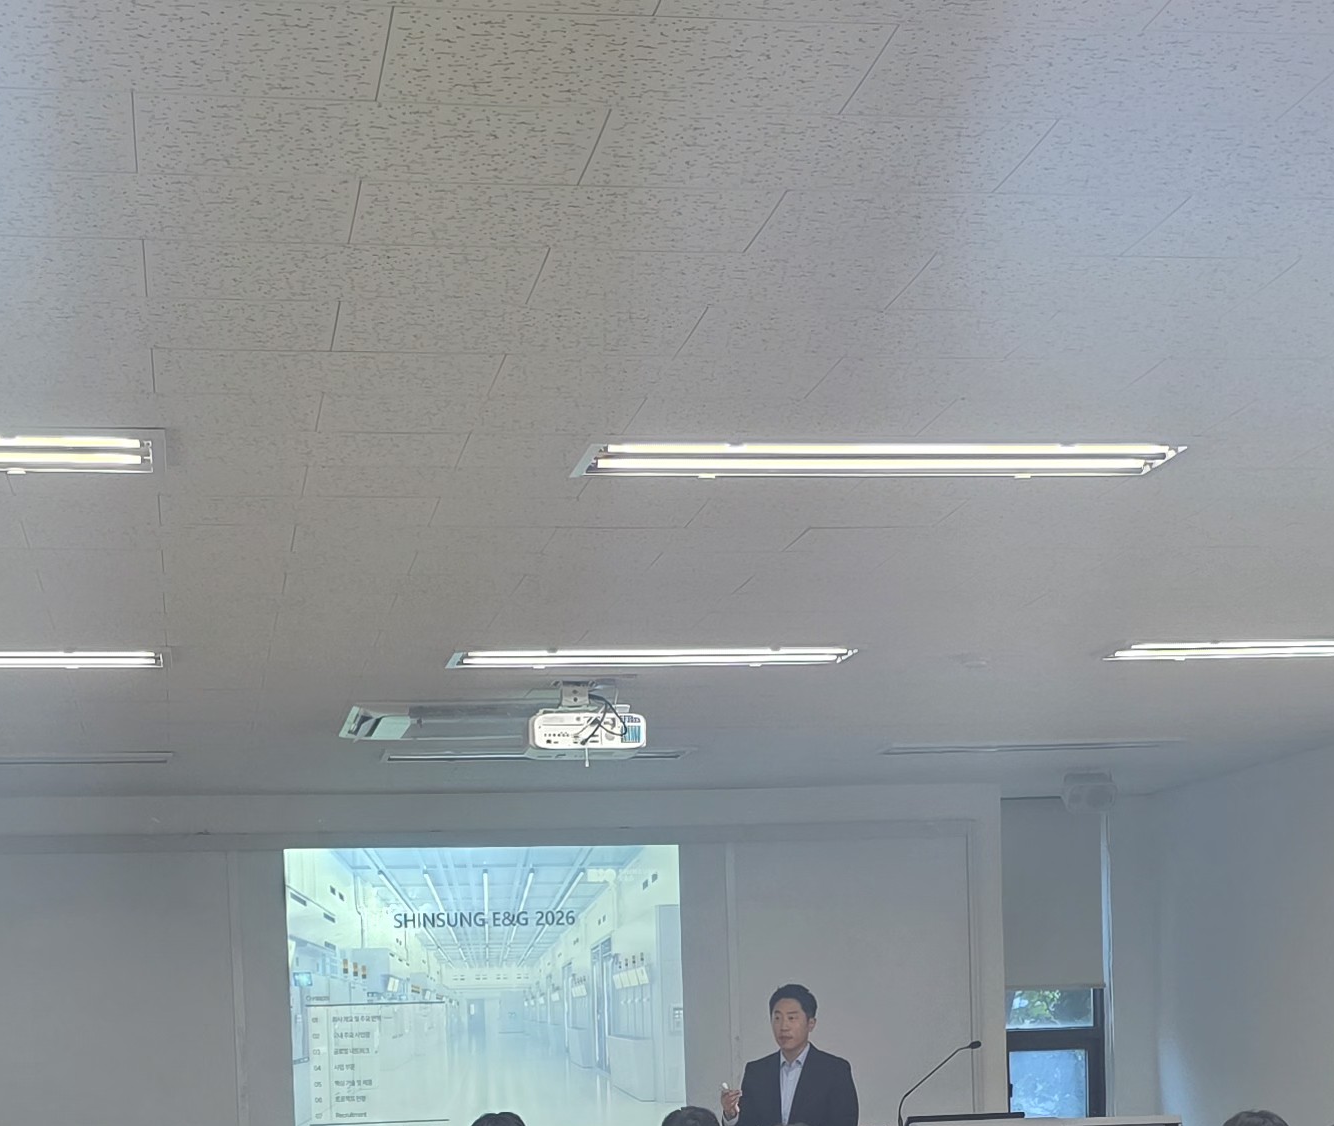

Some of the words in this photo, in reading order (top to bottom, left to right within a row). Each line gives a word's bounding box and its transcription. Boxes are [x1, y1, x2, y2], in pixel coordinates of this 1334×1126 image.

[394, 911, 485, 929] SHINSUNG
[492, 911, 529, 927] E&G
[535, 910, 576, 926] 2026
